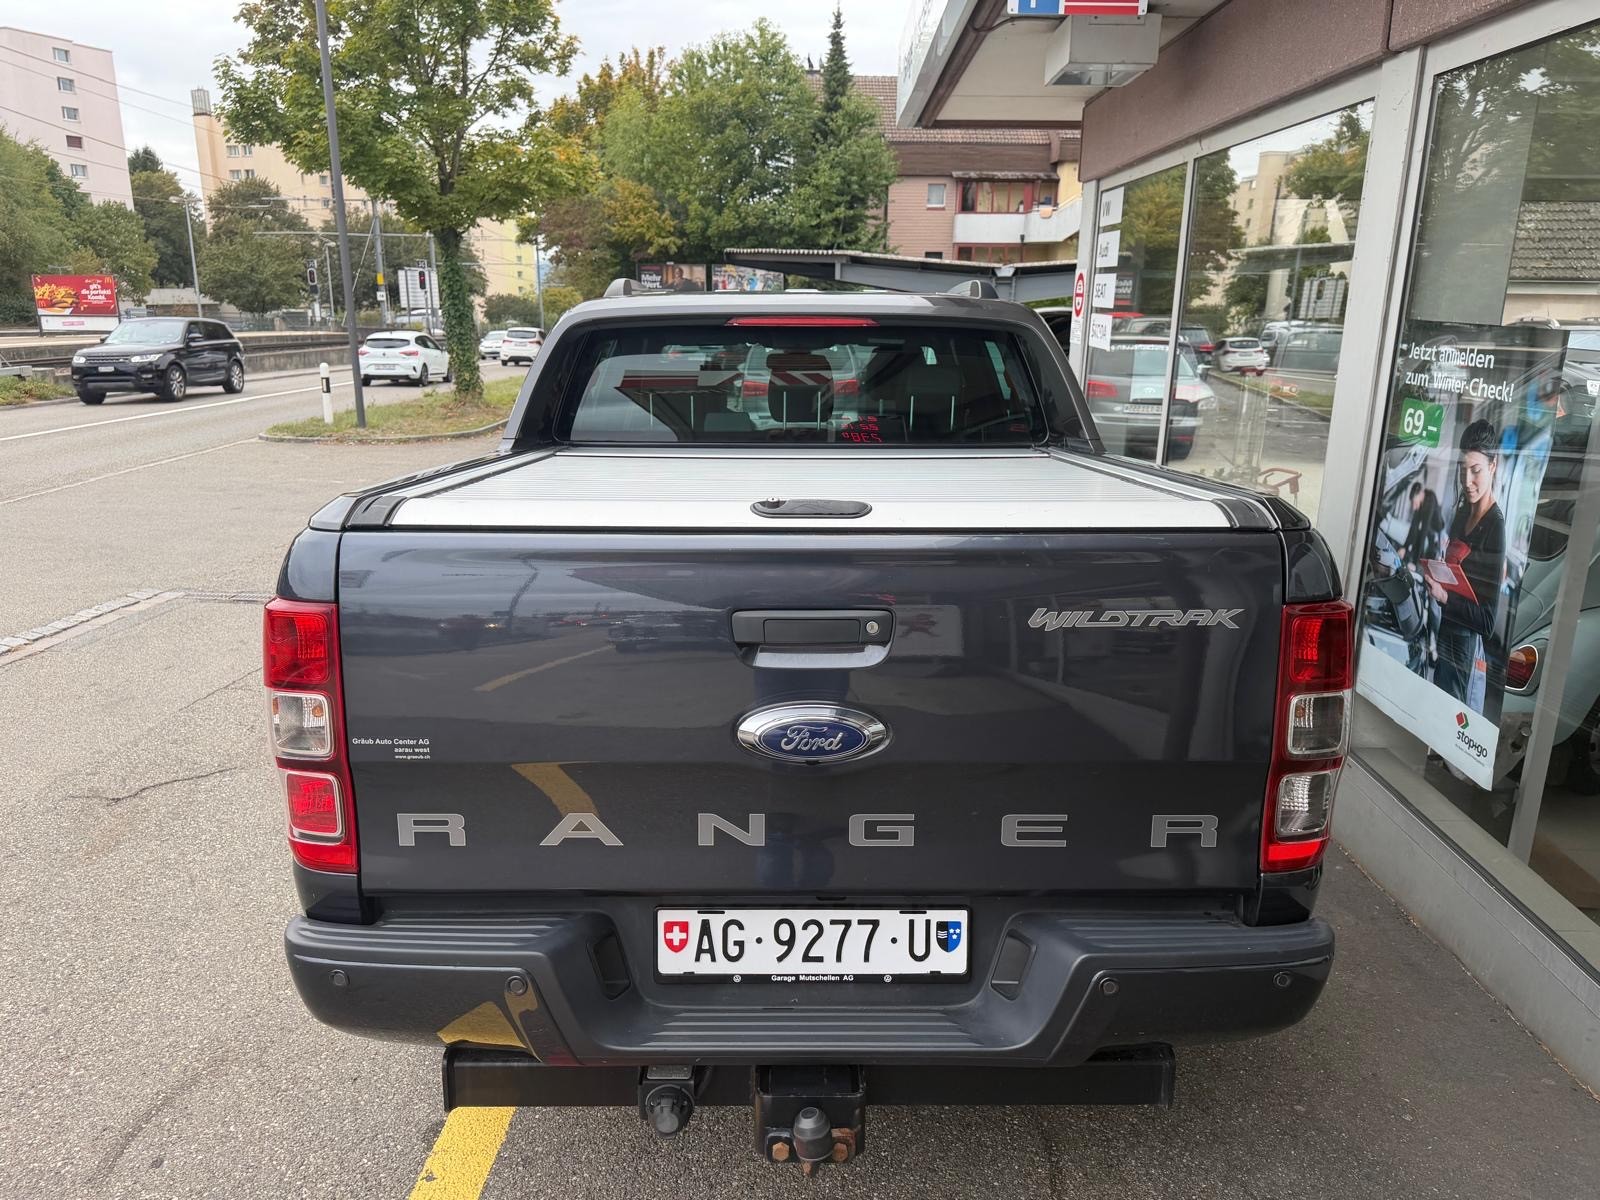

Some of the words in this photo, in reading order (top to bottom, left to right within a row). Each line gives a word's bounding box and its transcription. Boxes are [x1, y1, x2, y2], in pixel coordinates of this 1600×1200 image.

[641, 274, 662, 282] Mehr
[1094, 283, 1109, 299] SEAT
[1408, 342, 1438, 361] Jetzt
[1439, 346, 1495, 368] anmelden
[1405, 372, 1429, 387] zum
[1433, 372, 1514, 402] Winter-Check!
[1028, 607, 1243, 632] WILDTRAK
[781, 725, 842, 751] Ford
[1456, 729, 1488, 758] stop+go
[396, 812, 1218, 848] RANGER
[771, 974, 796, 983] Garage
[799, 974, 840, 982] Mutschellen
[843, 974, 854, 982] AG
